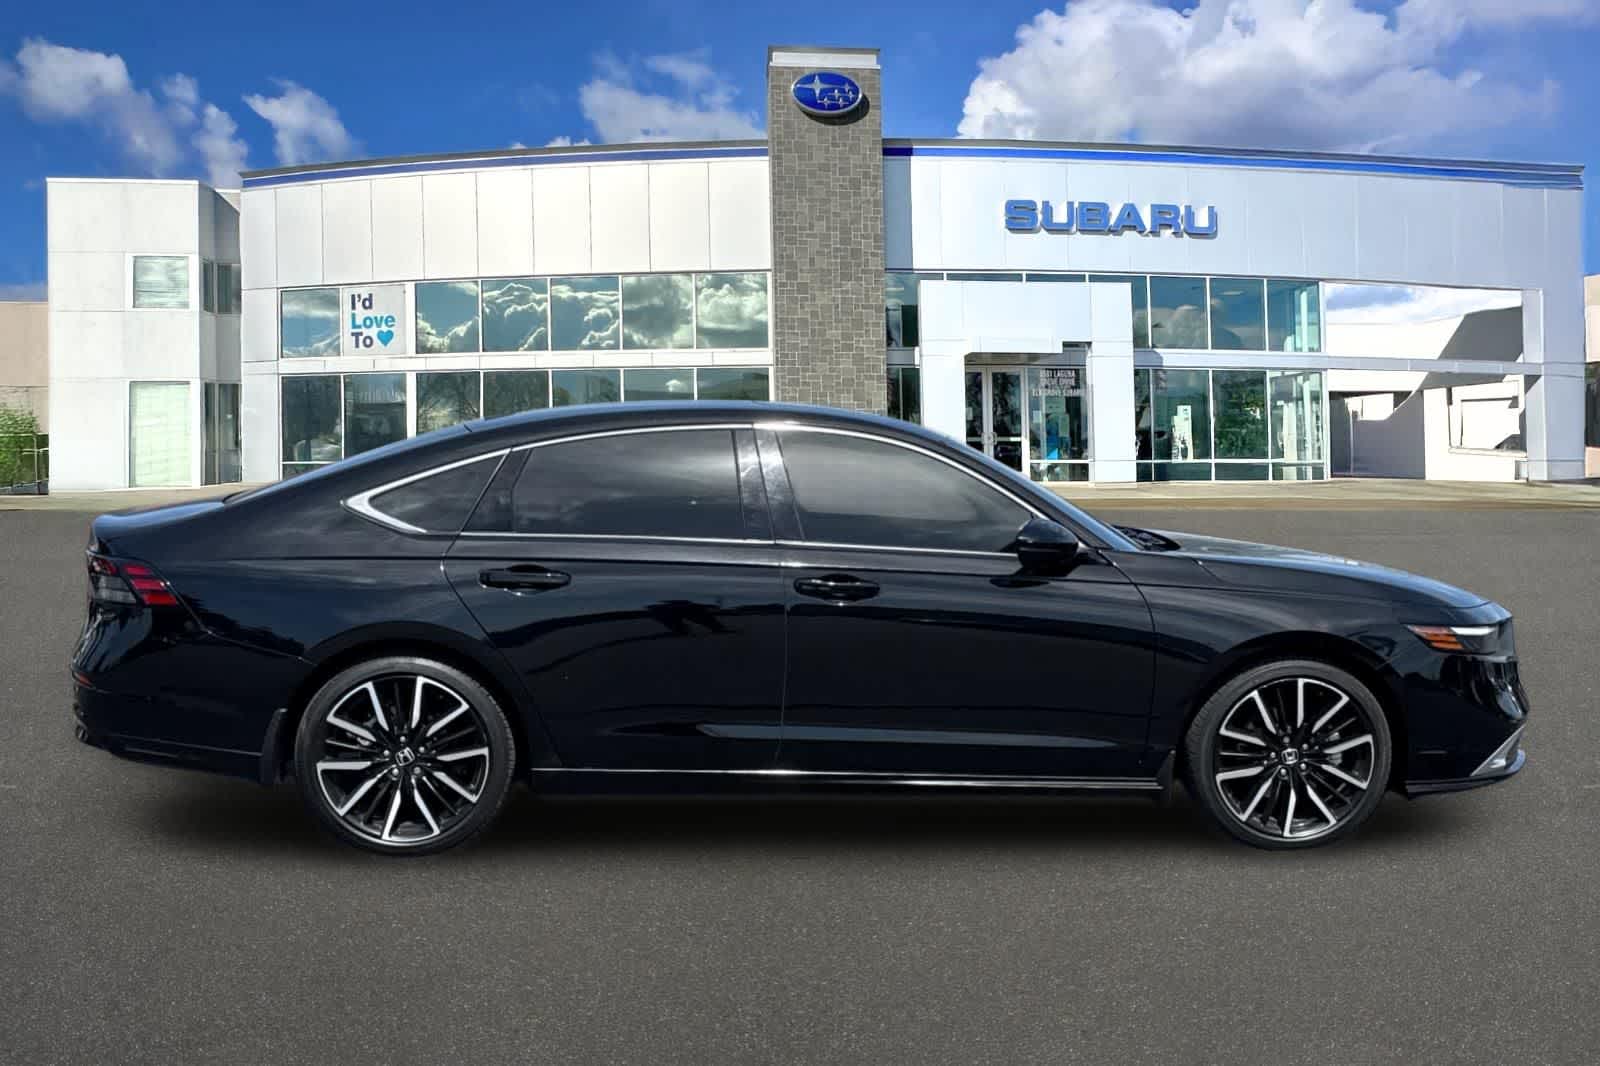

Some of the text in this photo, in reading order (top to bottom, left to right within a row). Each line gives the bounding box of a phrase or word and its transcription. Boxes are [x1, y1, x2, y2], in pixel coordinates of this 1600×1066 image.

[1005, 199, 1217, 238] SUBARU
[351, 313, 396, 329] Love
[351, 331, 374, 348] To
